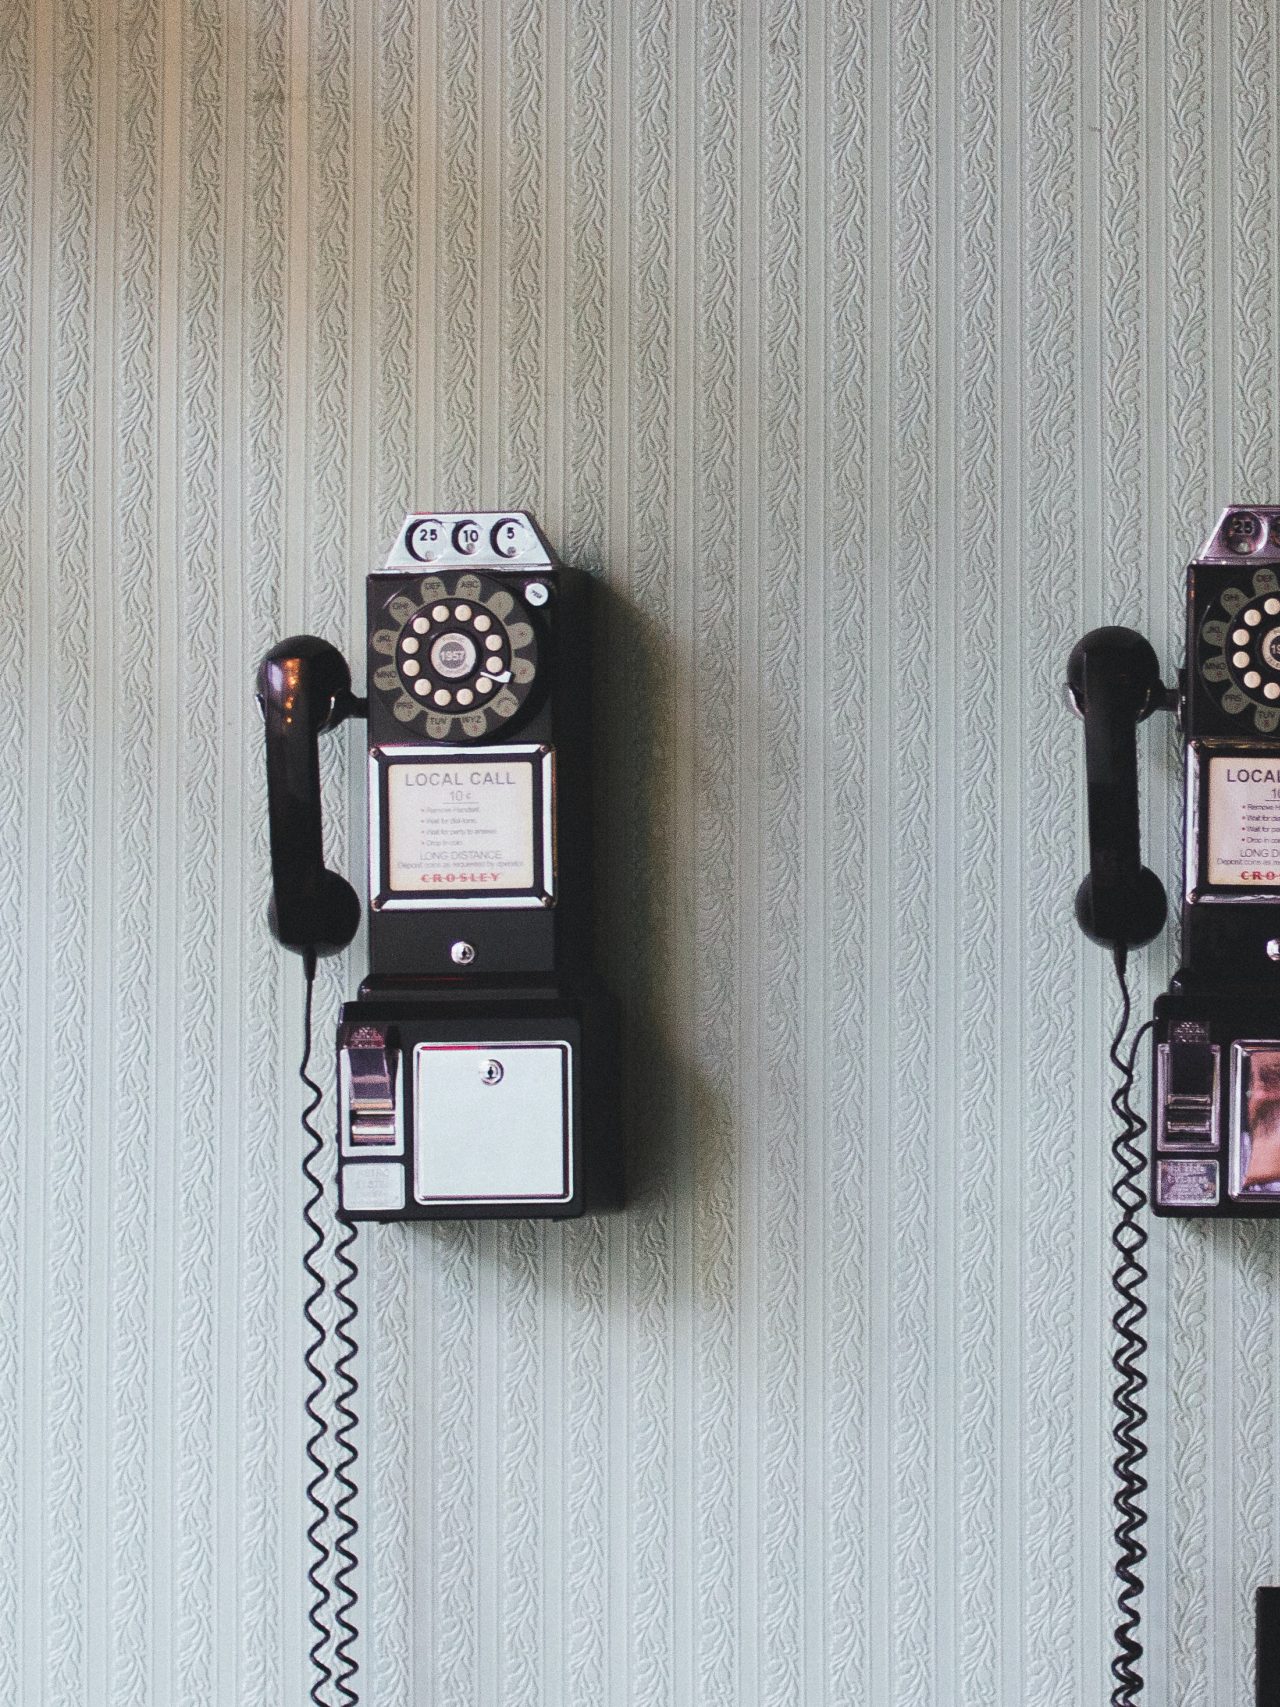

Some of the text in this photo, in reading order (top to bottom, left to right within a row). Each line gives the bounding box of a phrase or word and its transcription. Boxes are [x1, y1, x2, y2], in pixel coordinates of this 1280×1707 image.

[1233, 520, 1254, 535] 25
[420, 527, 515, 543] 25 10 5
[441, 651, 464, 661] 1957
[405, 772, 516, 786] LOCAL CALL
[450, 791, 463, 801] 10
[420, 850, 503, 861] LONG DISTANCE
[1240, 849, 1269, 858] LONG
[1217, 858, 1242, 866] Deposit
[420, 873, 501, 883] CROSLEY
